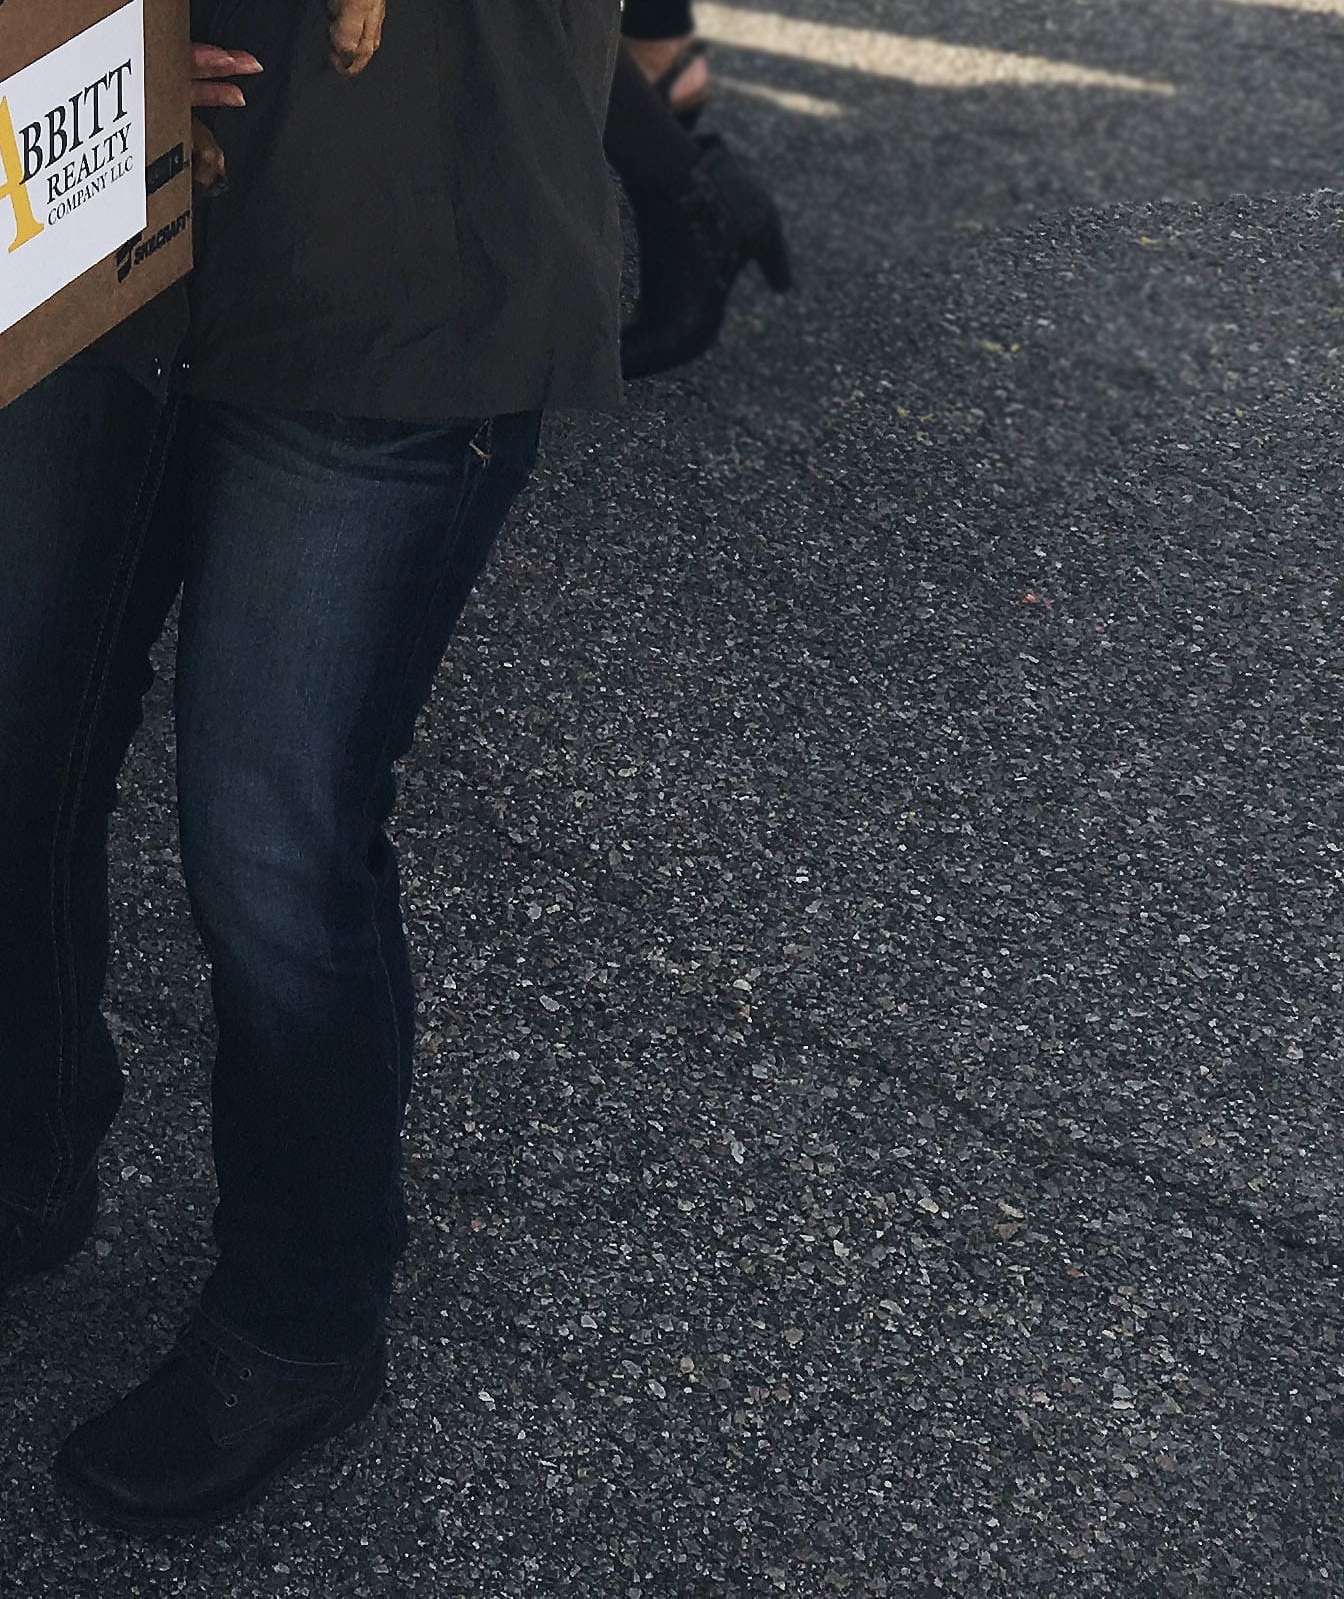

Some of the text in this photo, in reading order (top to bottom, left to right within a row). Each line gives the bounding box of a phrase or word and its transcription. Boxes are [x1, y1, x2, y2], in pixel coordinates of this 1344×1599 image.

[47, 122, 132, 205] REALTY
[48, 171, 108, 226] COMPANY
[110, 155, 134, 184] LLC
